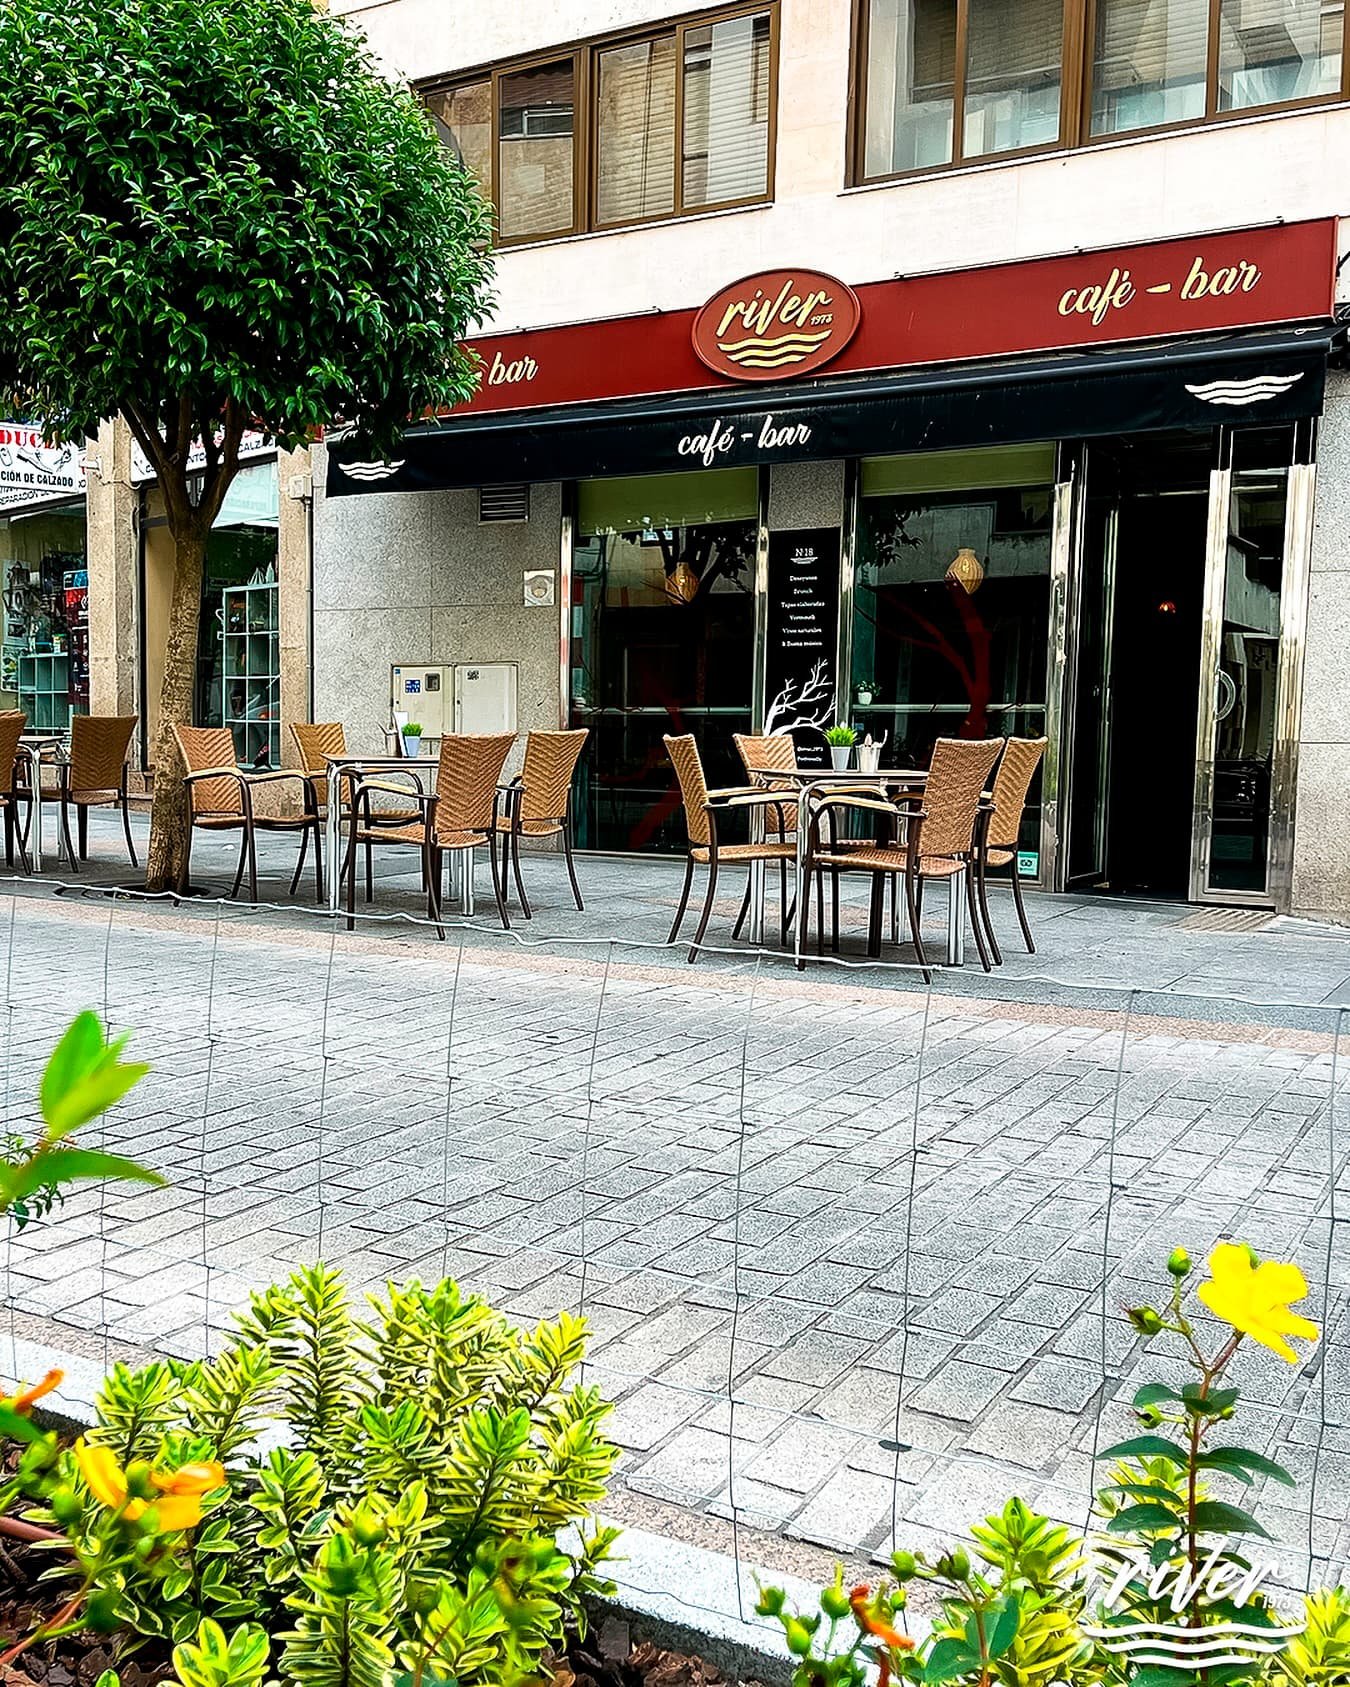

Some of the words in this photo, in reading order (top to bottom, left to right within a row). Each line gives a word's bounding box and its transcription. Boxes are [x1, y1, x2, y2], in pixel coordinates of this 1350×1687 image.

[715, 279, 833, 338] river
[1057, 267, 1137, 326] café
[1179, 256, 1263, 300] bar
[487, 351, 539, 386] bar
[677, 419, 735, 467] café
[757, 414, 812, 449] bar
[24, 473, 35, 484] DE
[37, 475, 74, 488] CALZADO
